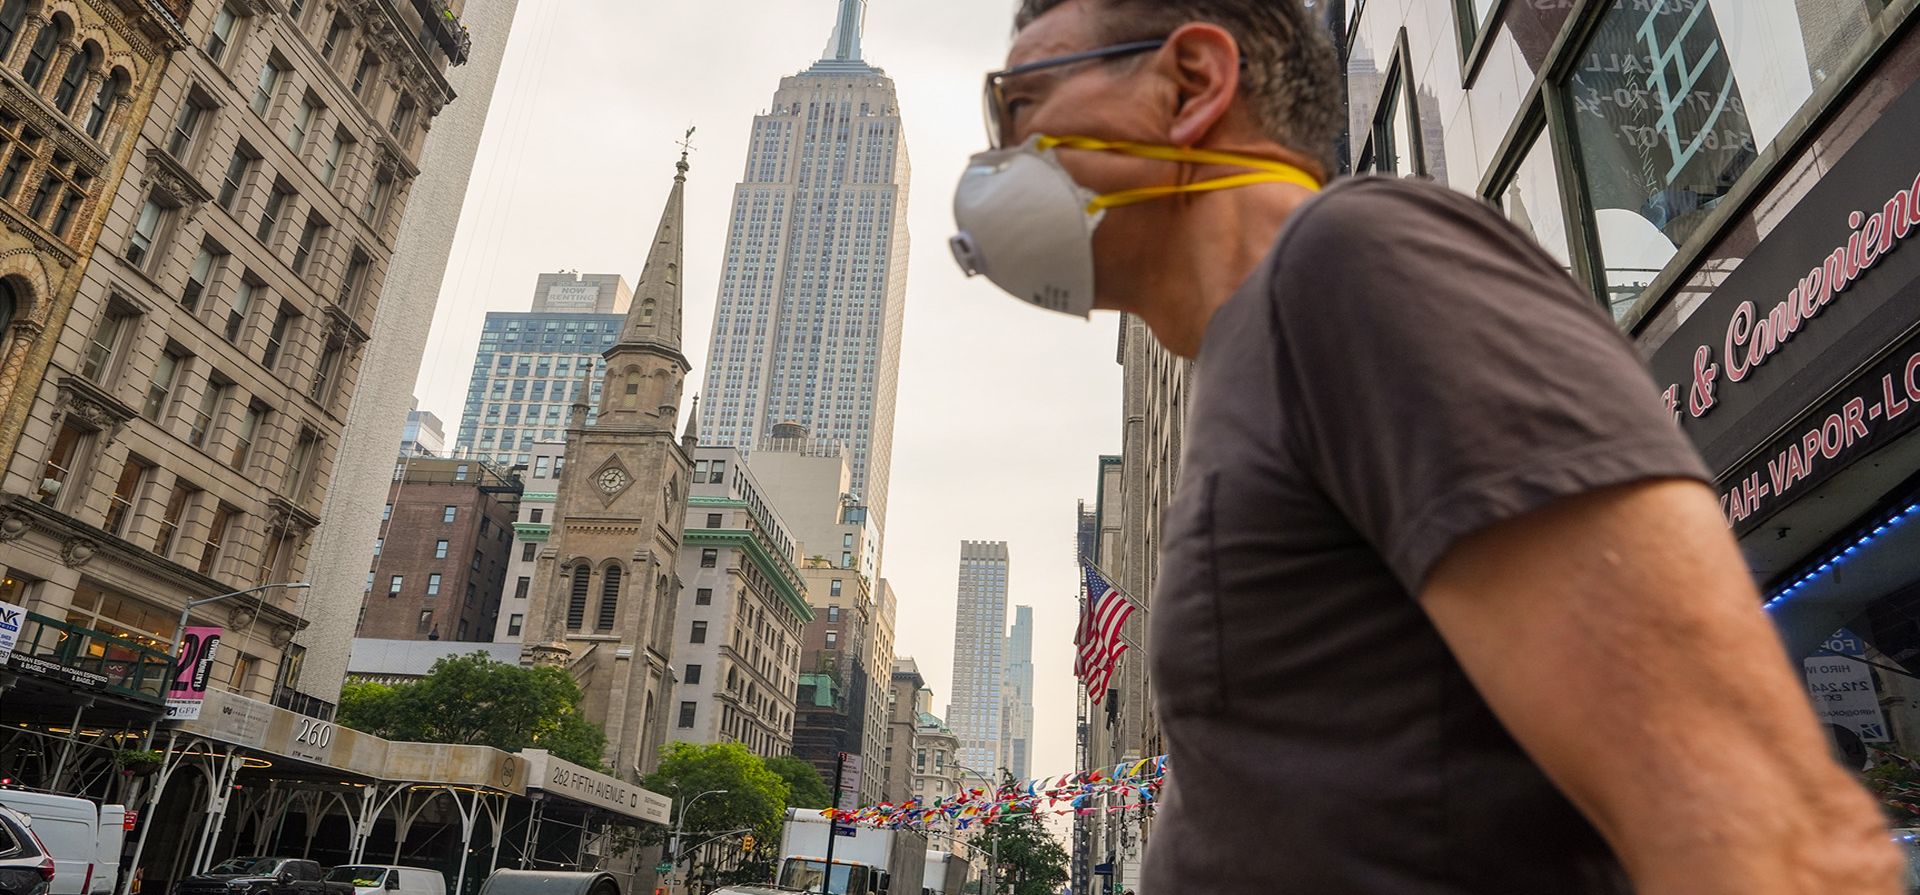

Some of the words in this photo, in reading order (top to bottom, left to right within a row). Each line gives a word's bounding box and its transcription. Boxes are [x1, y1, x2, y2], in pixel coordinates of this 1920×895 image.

[1689, 345, 1717, 418] &
[207, 639, 220, 661] NOMAD
[10, 652, 34, 665] MADMAN
[33, 656, 61, 671] ESPRESSO
[25, 662, 47, 674] BAGELS
[61, 666, 84, 678] MADMAN
[83, 671, 108, 683] ESPRESSO
[76, 675, 96, 686] BAGELS
[193, 658, 208, 688] FLATIRON
[296, 718, 331, 749] 260
[553, 766, 570, 787] 262
[571, 773, 594, 795] FIFTH
[595, 781, 626, 805] AVENUE
